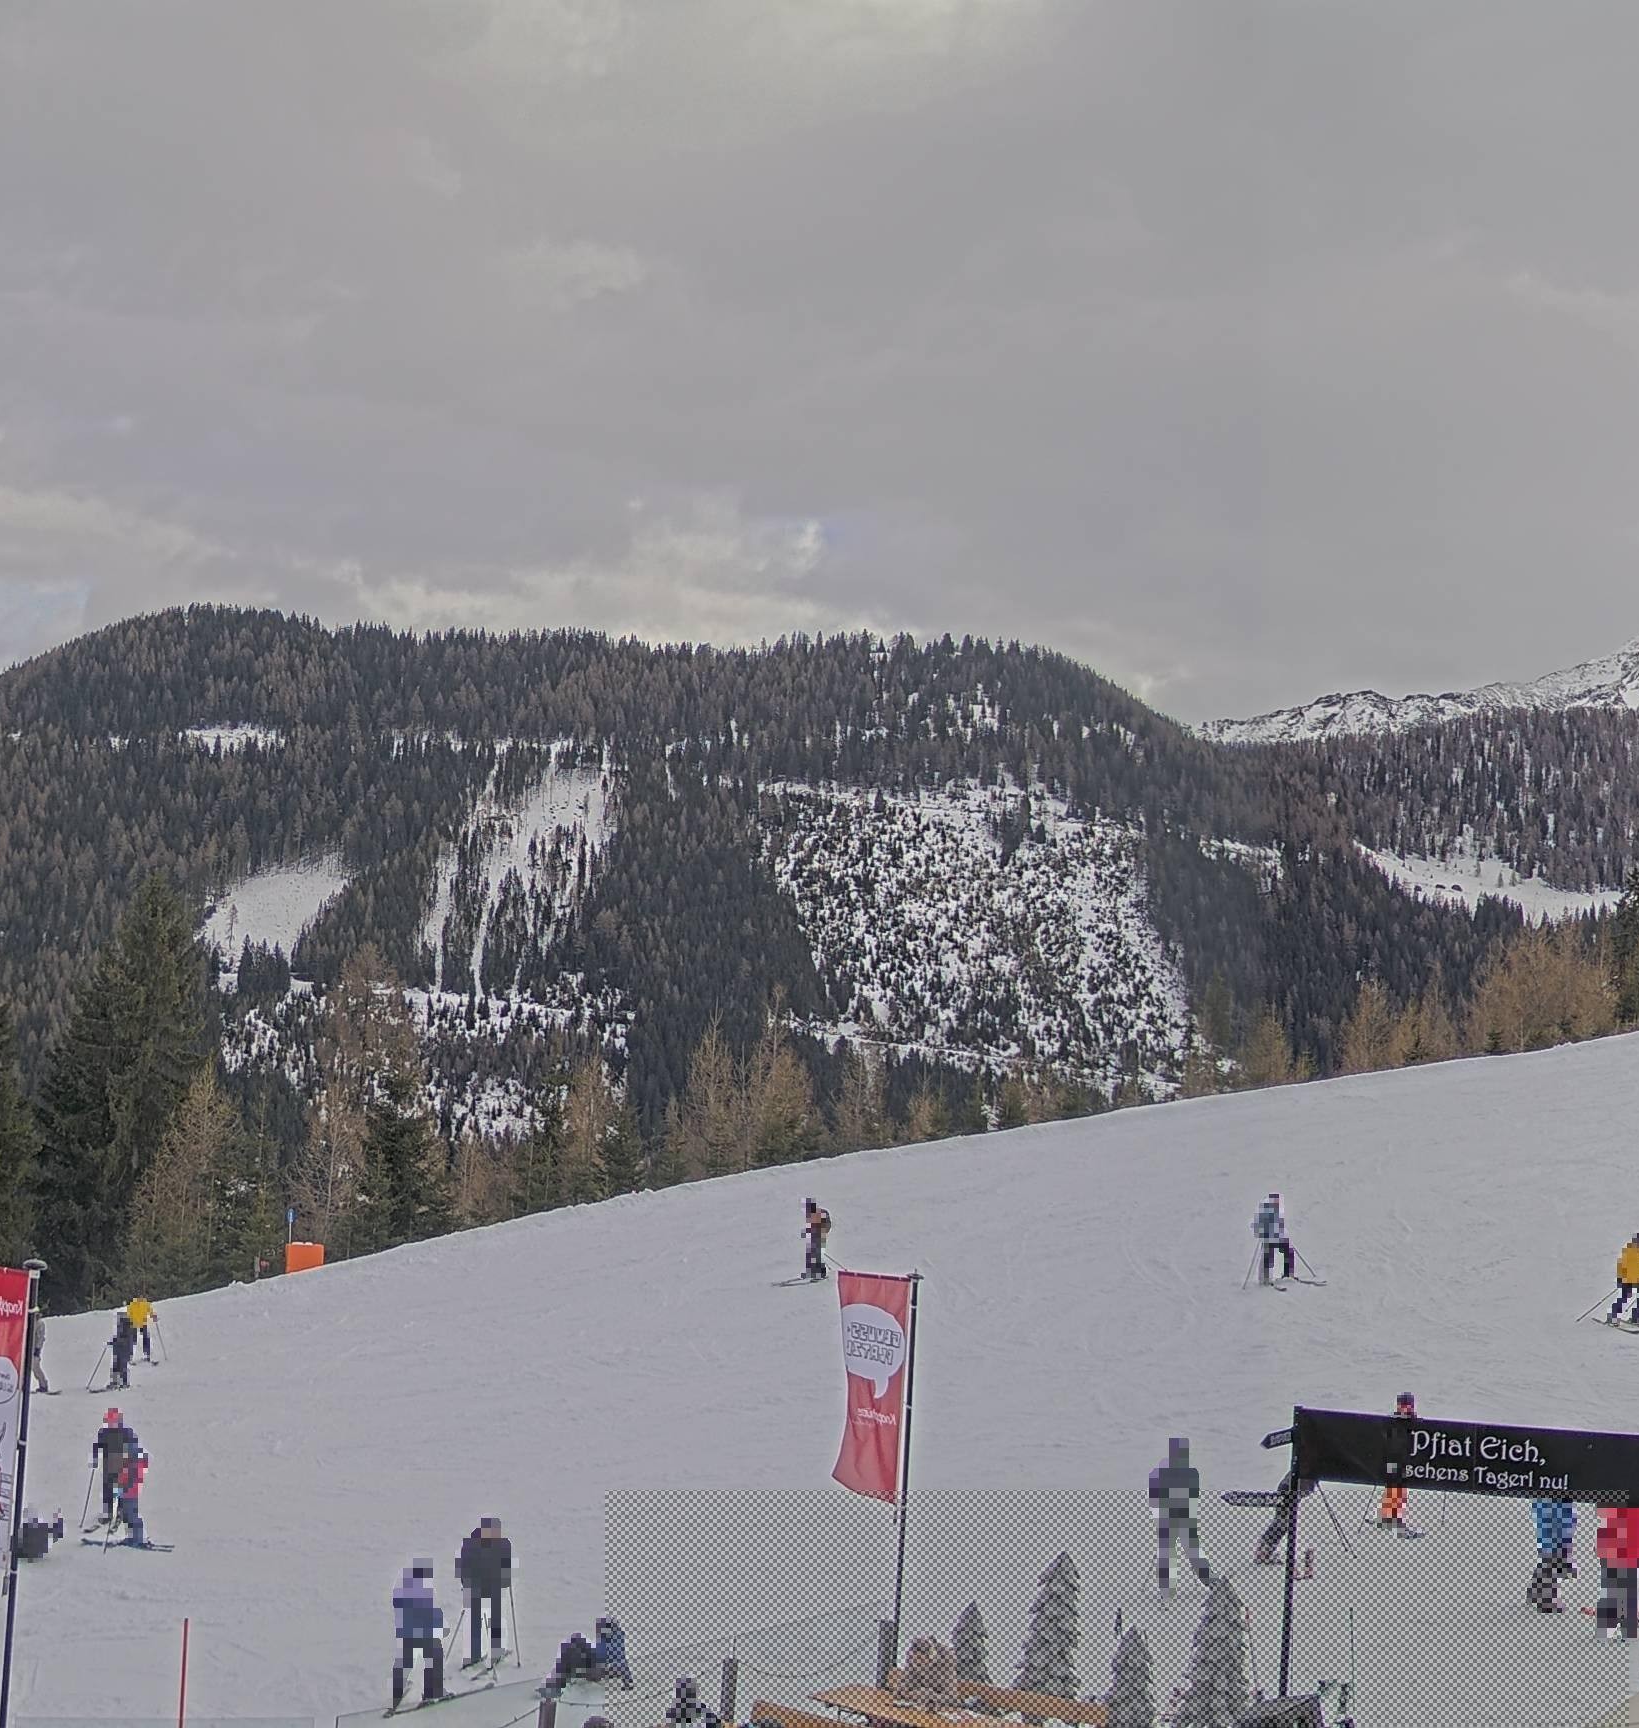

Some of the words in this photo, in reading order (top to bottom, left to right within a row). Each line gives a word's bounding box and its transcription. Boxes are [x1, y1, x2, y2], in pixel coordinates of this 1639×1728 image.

[1410, 1430, 1472, 1460] Pfiat
[1480, 1436, 1546, 1467] Eich,
[1405, 1462, 1469, 1482] schens
[1474, 1467, 1533, 1489] Tagerl
[1539, 1474, 1569, 1490] nu!
